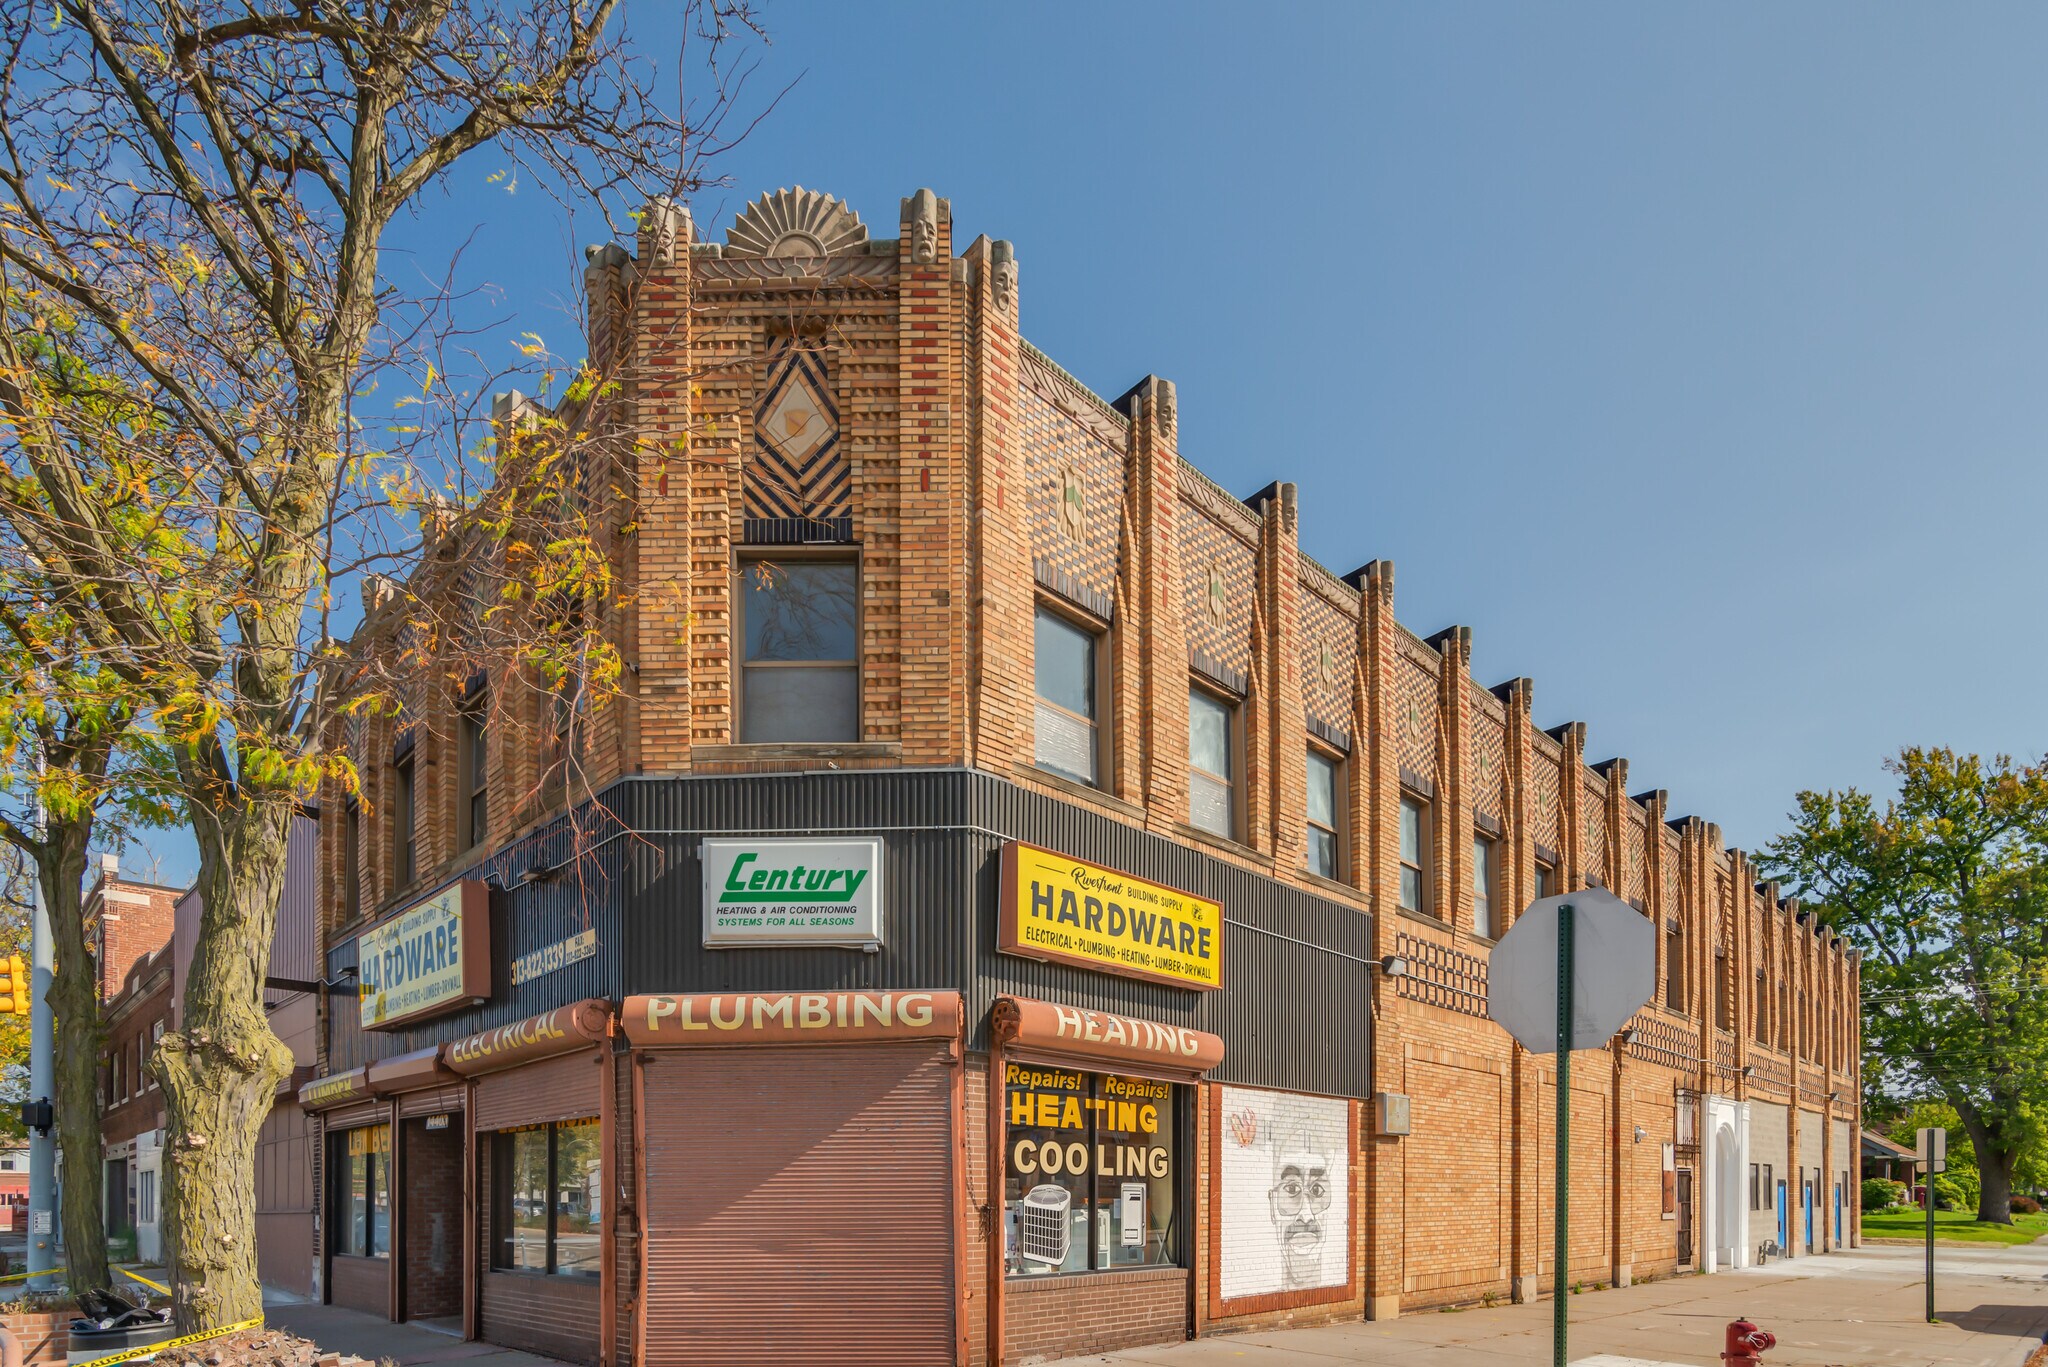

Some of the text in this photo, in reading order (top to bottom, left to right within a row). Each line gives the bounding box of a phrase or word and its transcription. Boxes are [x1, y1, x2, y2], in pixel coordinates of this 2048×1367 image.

[720, 853, 868, 902] Century
[1070, 866, 1183, 912] Riverfront BUILDING SUPPLY
[403, 914, 421, 934] BUILDING
[422, 908, 436, 925] SUPPLY
[716, 905, 857, 915] HEATING & AIR CONDITIONING
[718, 917, 855, 926] SYSTEMS FOR ALL SEASONS
[1030, 880, 1212, 960] HARDWARE
[362, 916, 458, 997] HARDWARE
[511, 941, 564, 986] 313-822-1339
[1026, 926, 1212, 979] ELECTRICAL PLUMBING HEATING LUMBER DRYWALL
[403, 988, 420, 1007] HEATING
[423, 980, 440, 1000] LUMBER
[442, 974, 461, 993] DRYWALL
[648, 994, 933, 1031] PLUMBING
[1054, 1006, 1199, 1056] HEATING
[453, 1010, 565, 1064] ELECTRICAL
[1006, 1065, 1082, 1090] Repairs!
[1105, 1077, 1169, 1099] Repairs!
[1011, 1092, 1158, 1134] HEATING
[1014, 1139, 1168, 1178] COOLING
